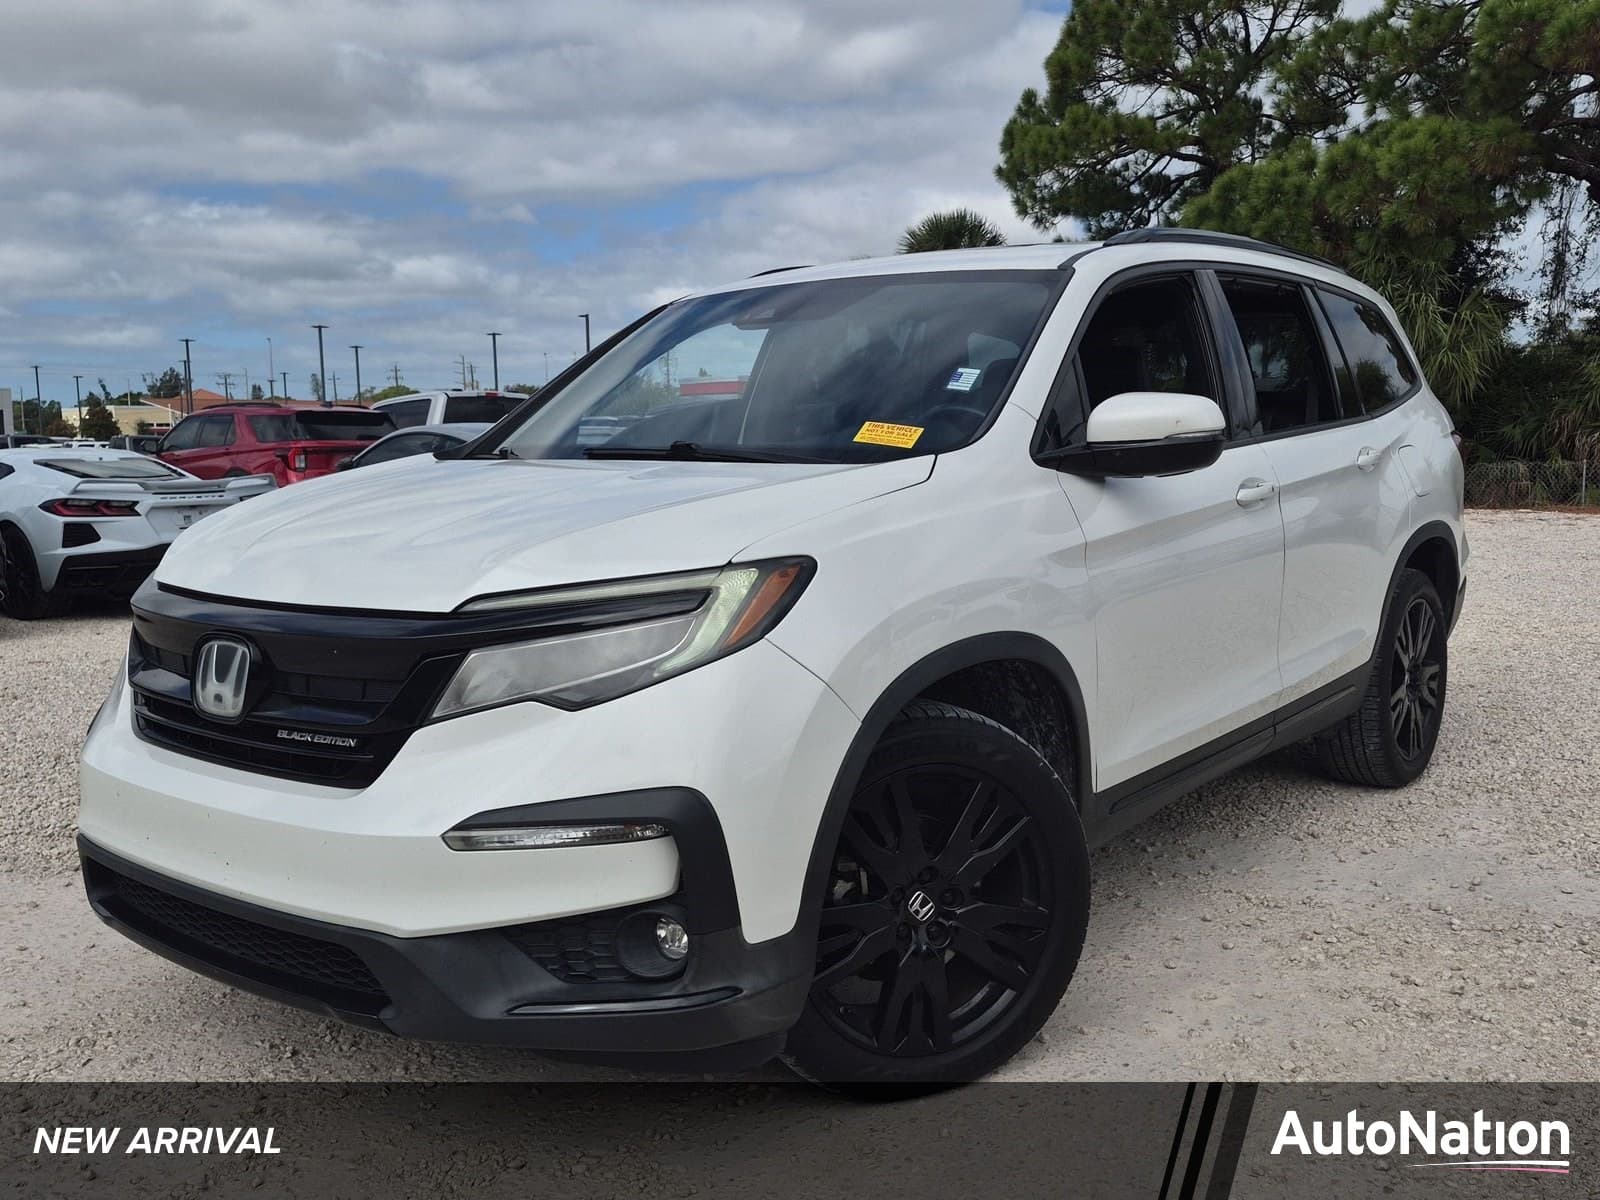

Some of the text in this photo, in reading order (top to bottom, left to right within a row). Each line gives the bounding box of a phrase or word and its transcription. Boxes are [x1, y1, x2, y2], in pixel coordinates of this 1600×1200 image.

[867, 422, 919, 434] THIS VEHICLE
[277, 729, 357, 747] BLACK EDITION
